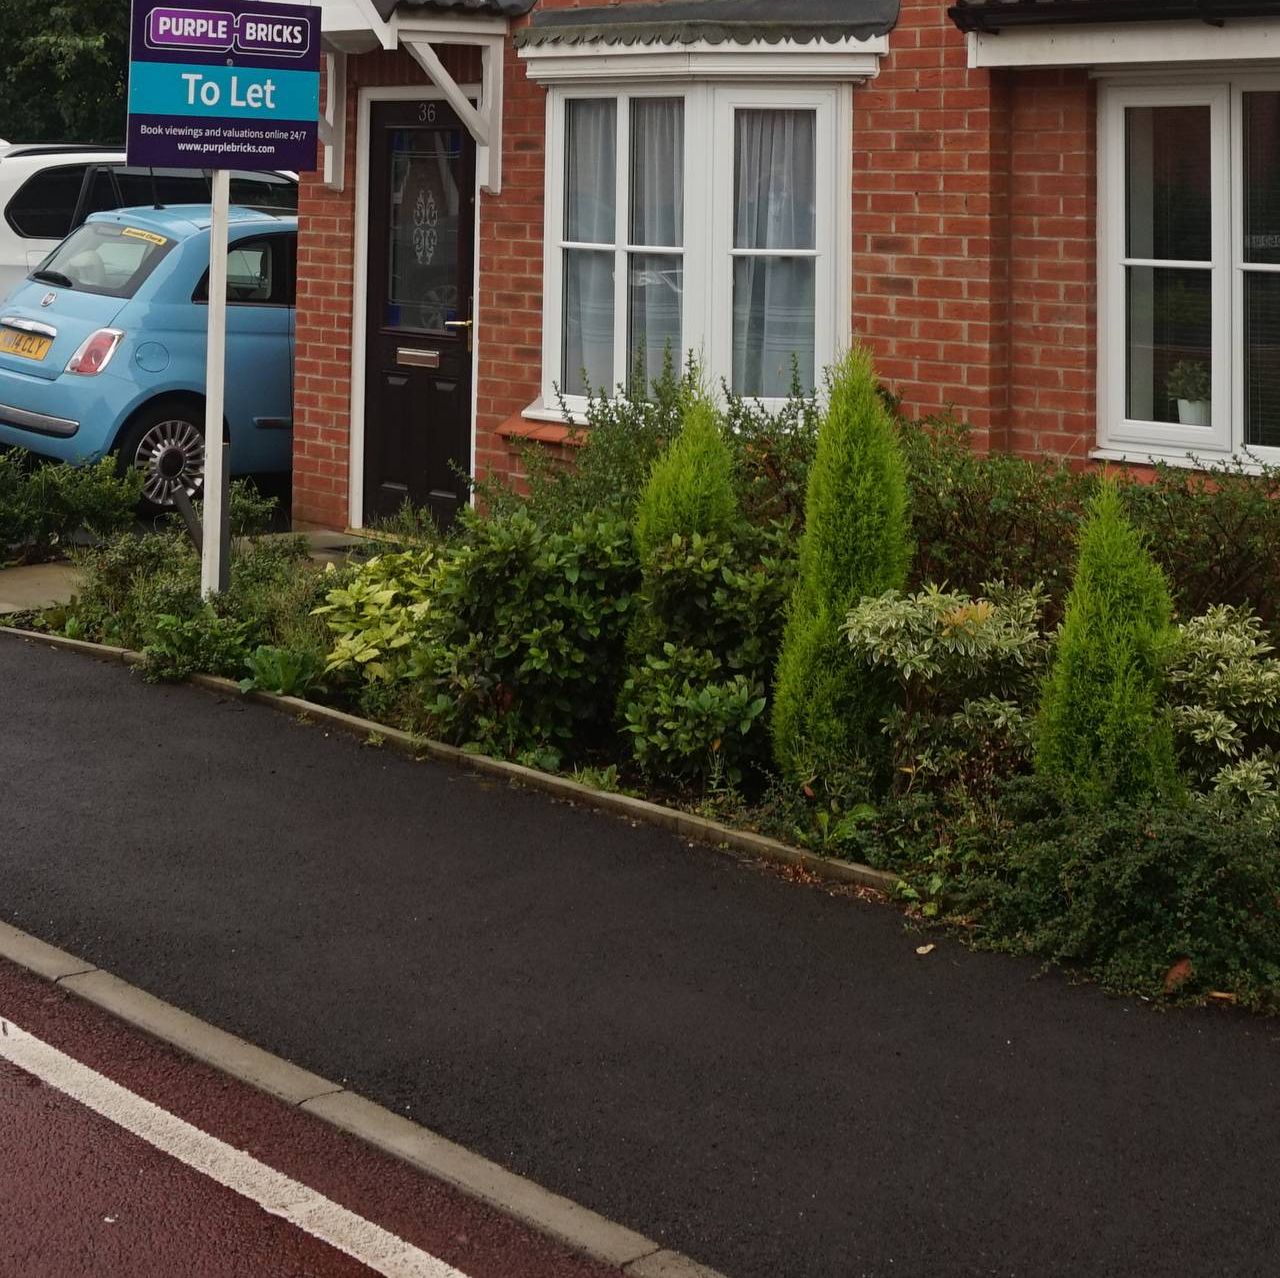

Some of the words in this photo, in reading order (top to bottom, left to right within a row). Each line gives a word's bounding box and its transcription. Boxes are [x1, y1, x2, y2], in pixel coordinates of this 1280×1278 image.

[159, 16, 228, 38] PURPLE
[245, 22, 302, 43] BRICKS
[181, 73, 220, 106] To
[230, 76, 276, 108] Let
[418, 103, 436, 122] 36
[140, 124, 164, 135] Book
[165, 125, 203, 139] viewings
[204, 127, 221, 137] and
[222, 127, 264, 139] valuations
[265, 130, 289, 139] online
[289, 131, 307, 141] 24/7
[177, 142, 275, 154] www.purplebricks.com
[21, 336, 46, 355] CLY
